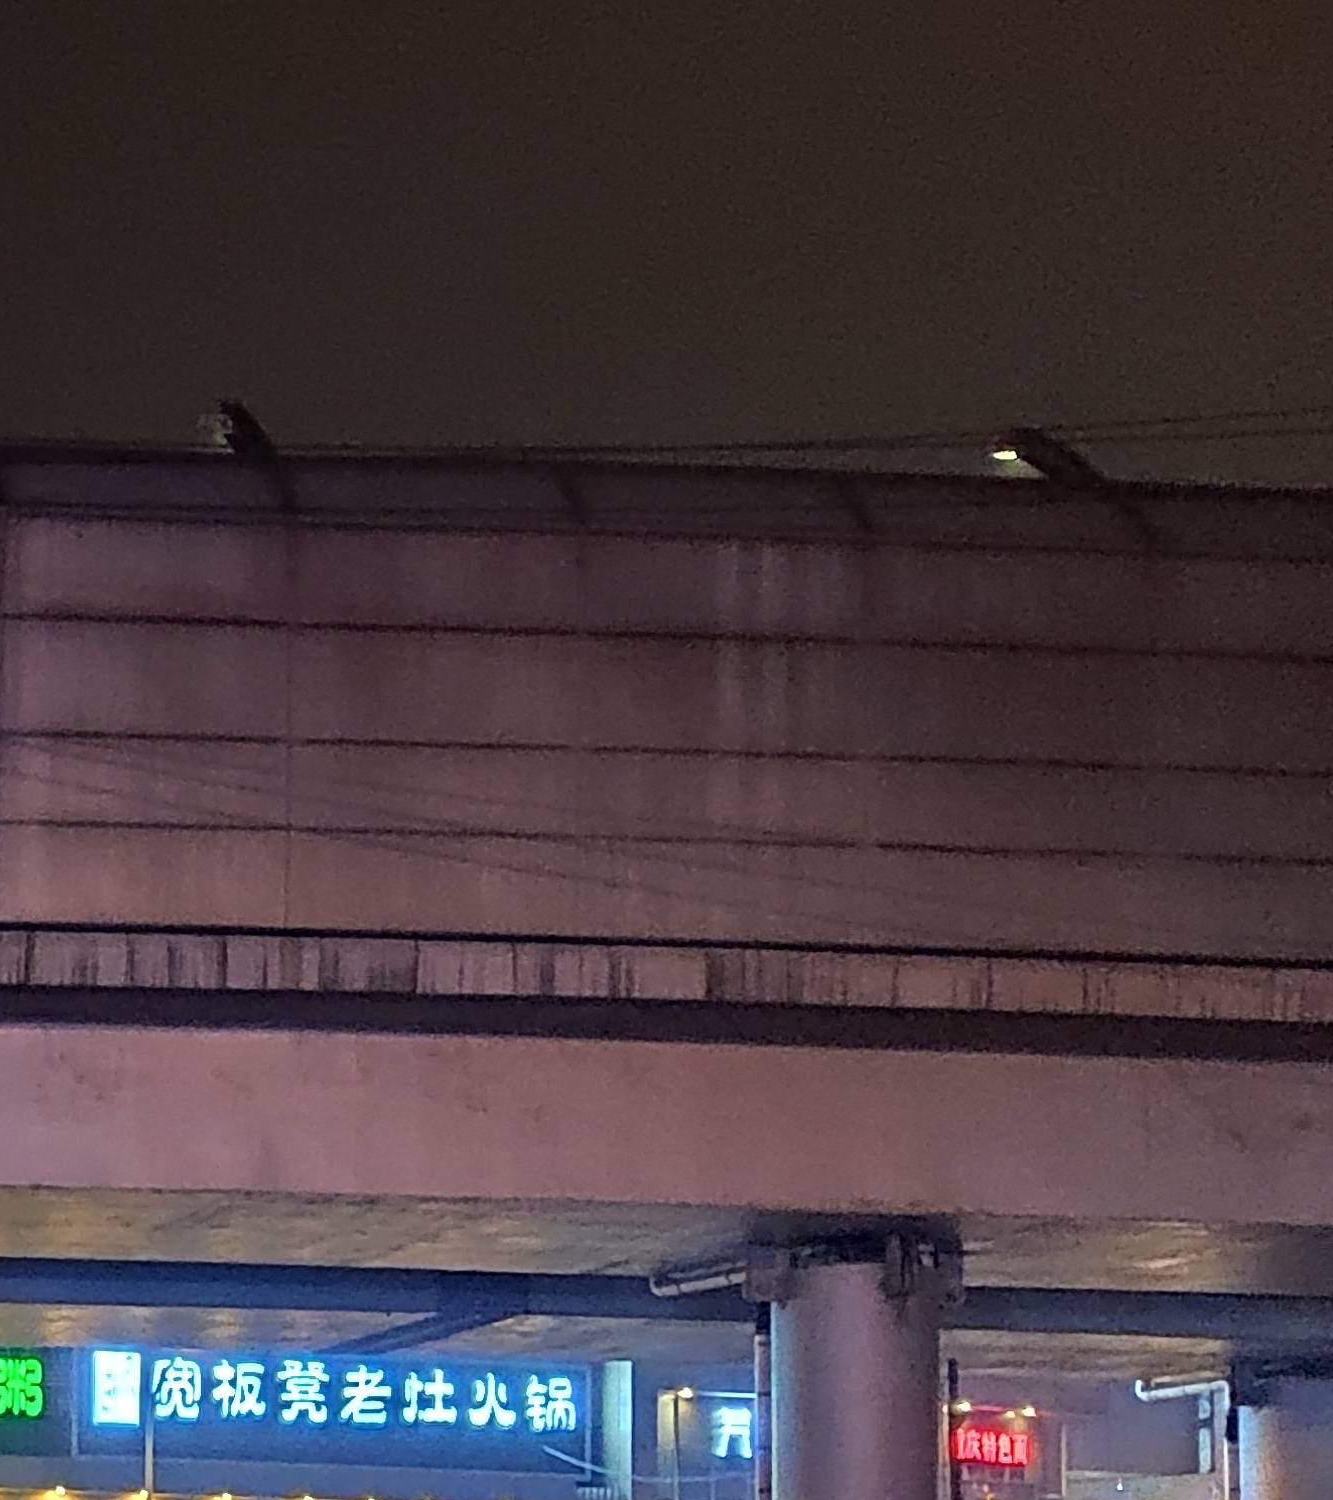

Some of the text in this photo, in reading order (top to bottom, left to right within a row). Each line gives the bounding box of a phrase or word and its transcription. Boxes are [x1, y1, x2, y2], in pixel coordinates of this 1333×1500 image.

[151, 1356, 576, 1432] 宽板凳老灶火锅
